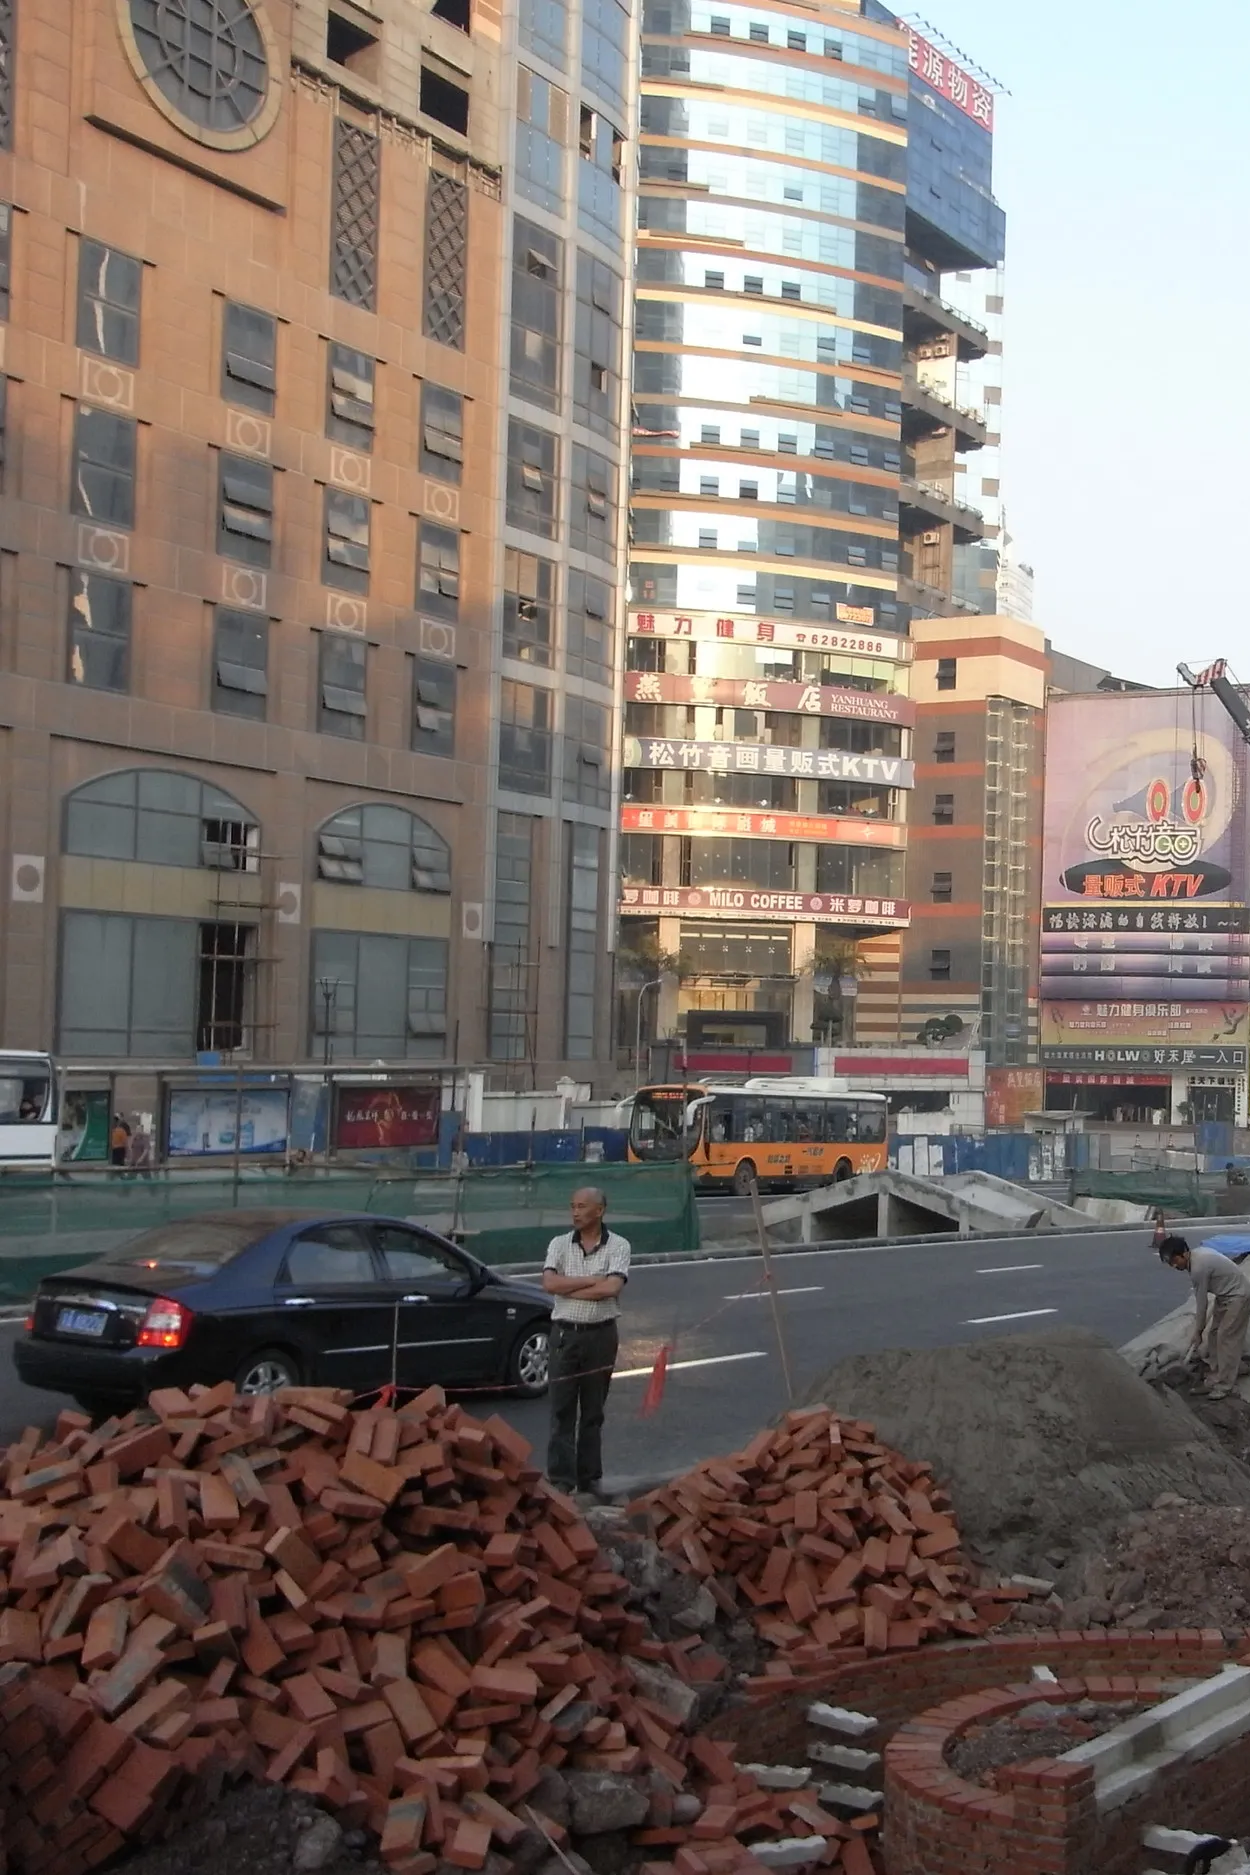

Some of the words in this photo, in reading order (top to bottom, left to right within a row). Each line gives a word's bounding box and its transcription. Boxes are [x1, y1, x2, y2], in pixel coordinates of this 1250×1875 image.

[636, 614, 775, 641] 魅力健身
[811, 634, 882, 652] 62822886
[831, 693, 888, 709] YANHUANG
[831, 703, 898, 720] RESTAURANT
[1150, 873, 1204, 897] KTV
[709, 892, 744, 907] MILO
[750, 895, 803, 911] COFFEE
[829, 898, 896, 916] 米罗咖啡
[1096, 1004, 1181, 1017] 魅力健身俱乐部
